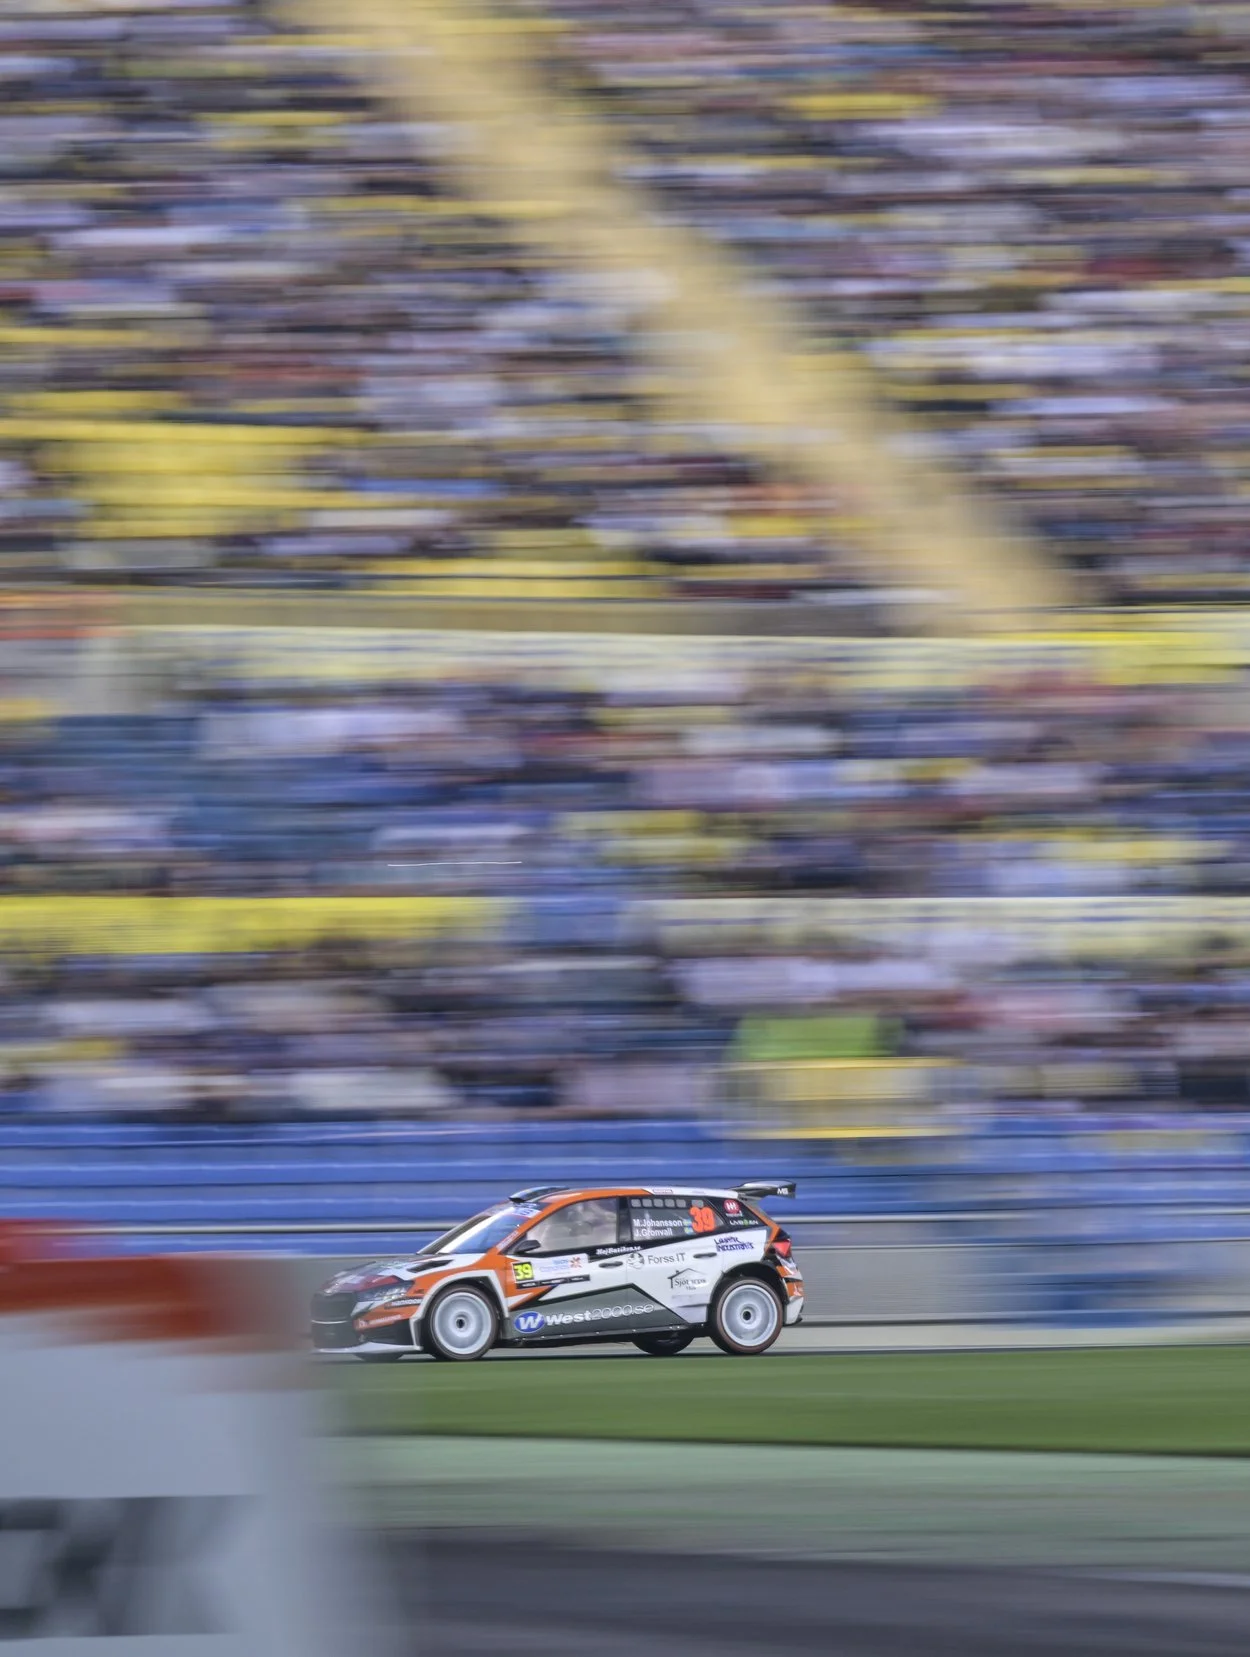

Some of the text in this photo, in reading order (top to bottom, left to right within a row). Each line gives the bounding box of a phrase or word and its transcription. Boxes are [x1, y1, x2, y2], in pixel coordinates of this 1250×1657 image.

[632, 1218, 683, 1227] M.Johansson
[689, 1206, 716, 1233] 39
[647, 1252, 686, 1264] Forss IT
[514, 1263, 533, 1280] 39
[545, 1304, 655, 1326] West2000.se
